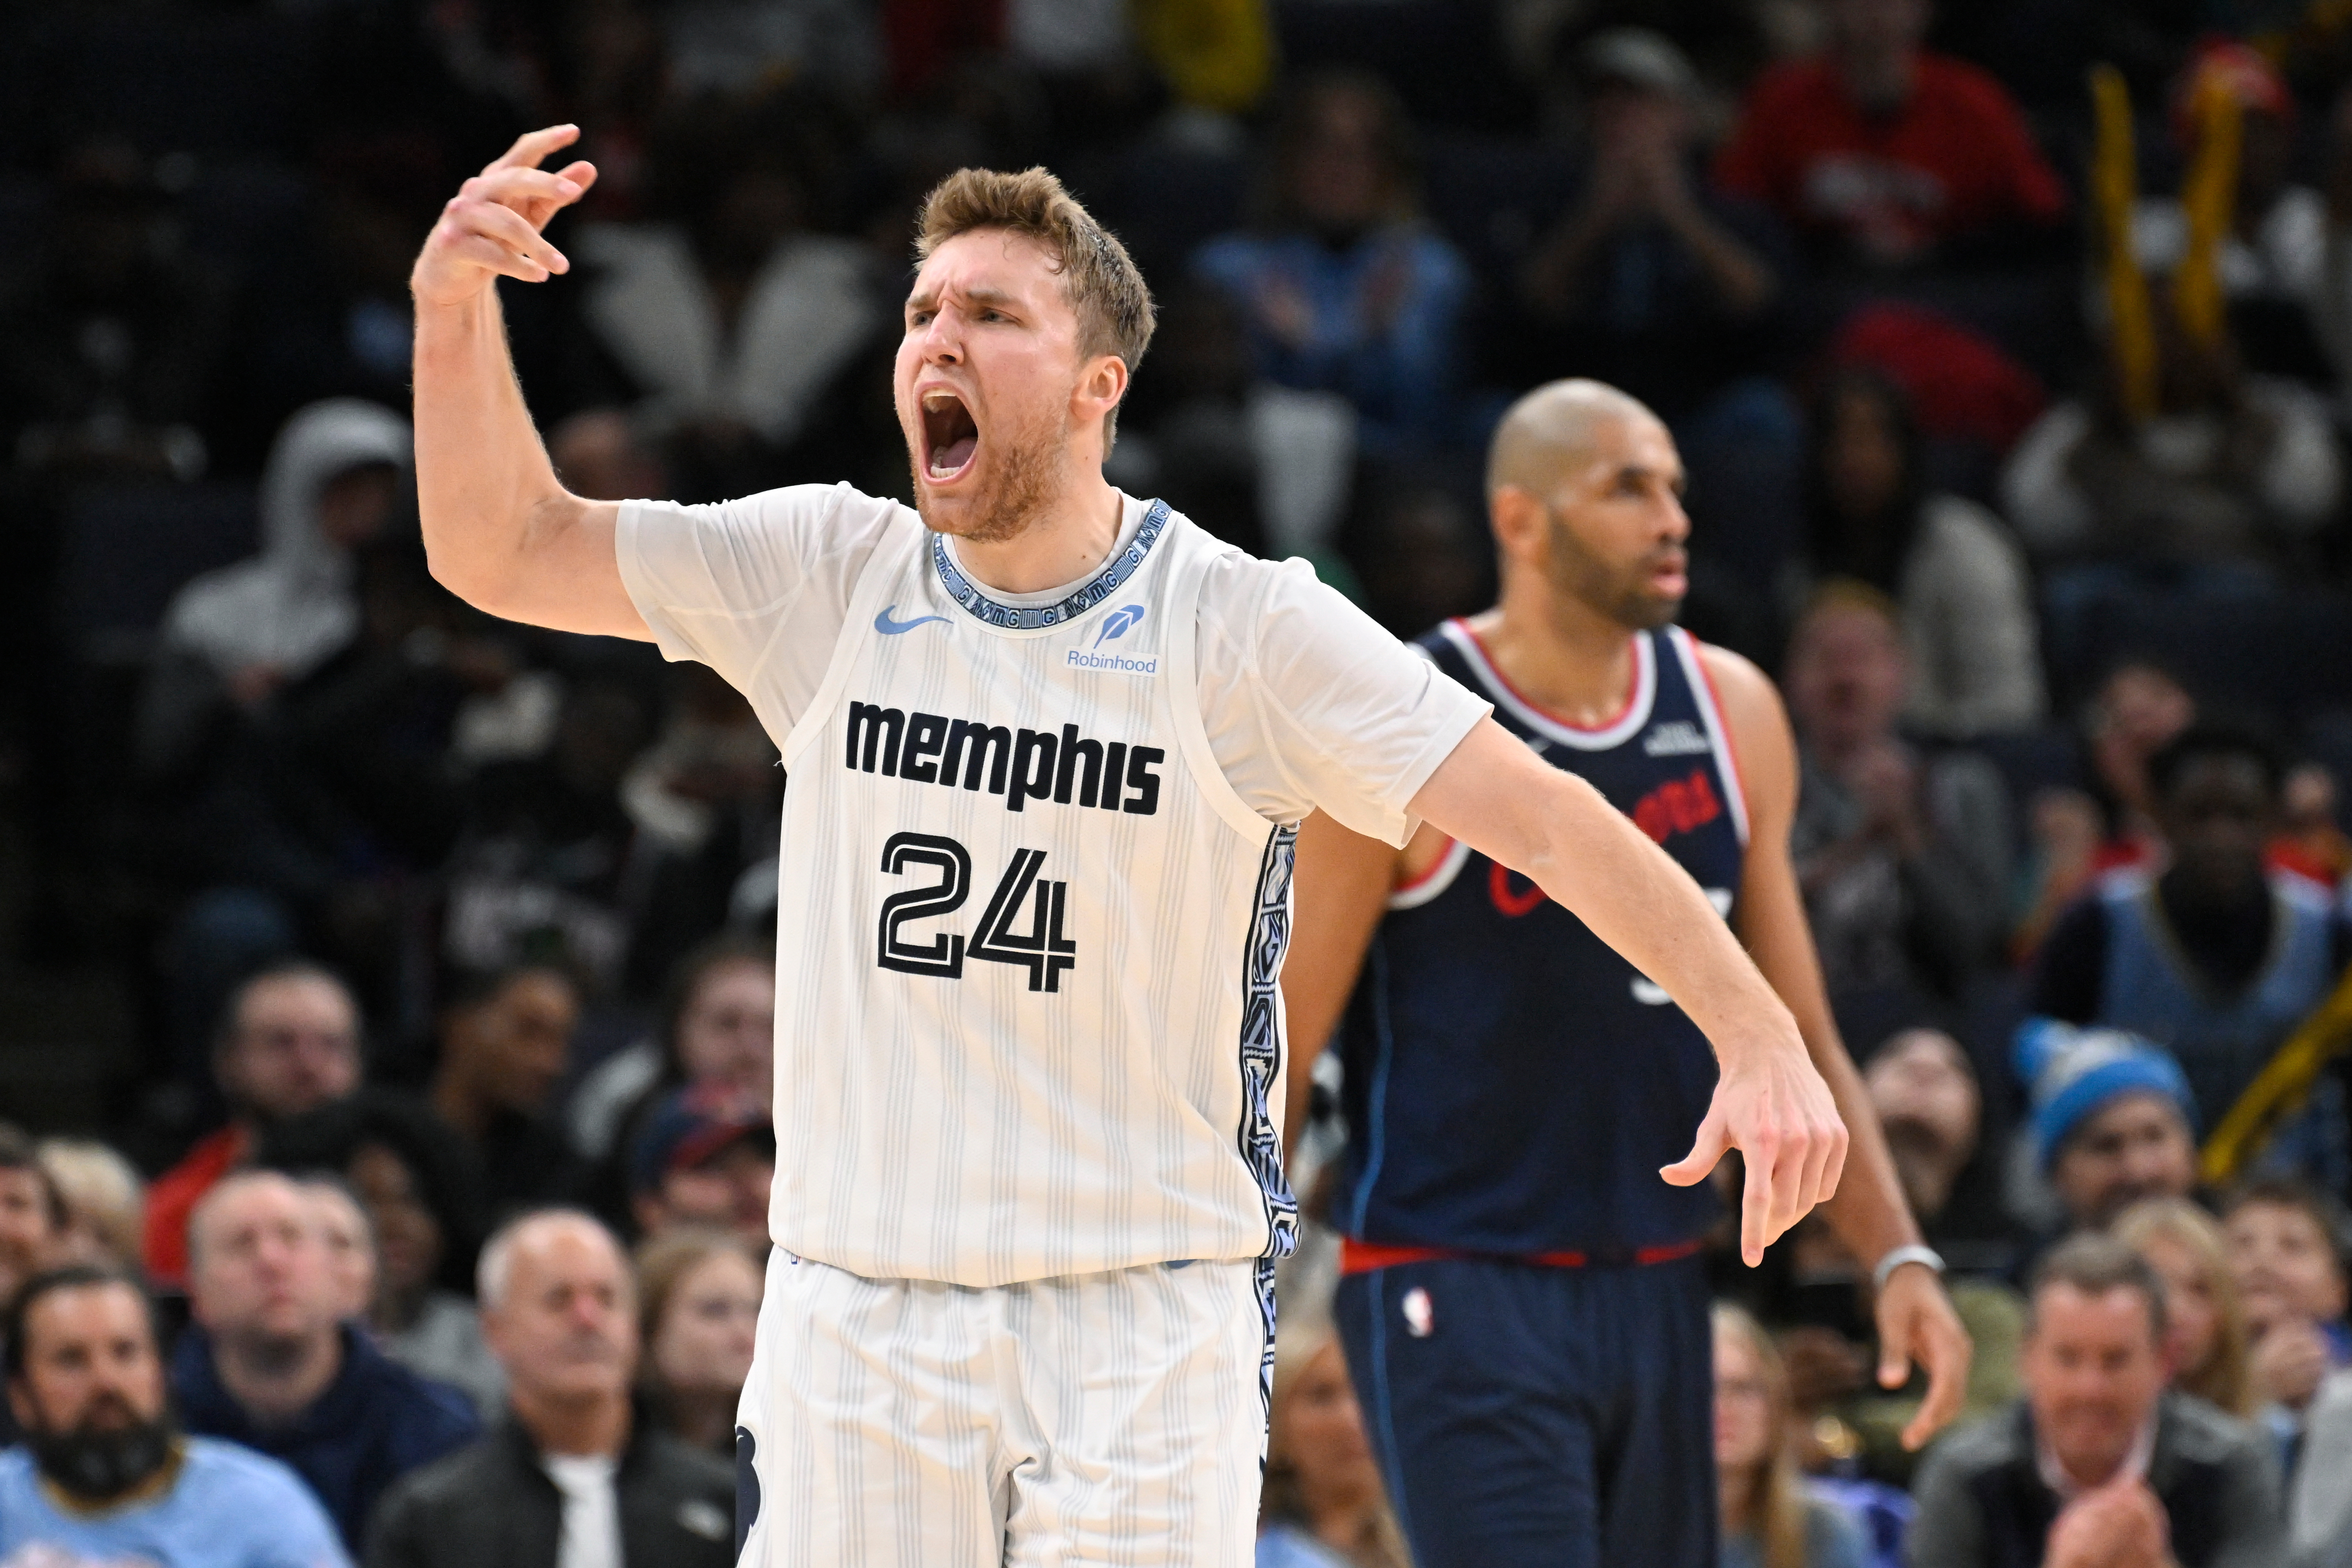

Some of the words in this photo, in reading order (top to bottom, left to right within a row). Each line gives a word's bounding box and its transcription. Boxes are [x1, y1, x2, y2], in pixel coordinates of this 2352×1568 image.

[1068, 650, 1157, 673] Robinhood
[846, 701, 1165, 815] memphis
[878, 831, 1076, 993] 24
